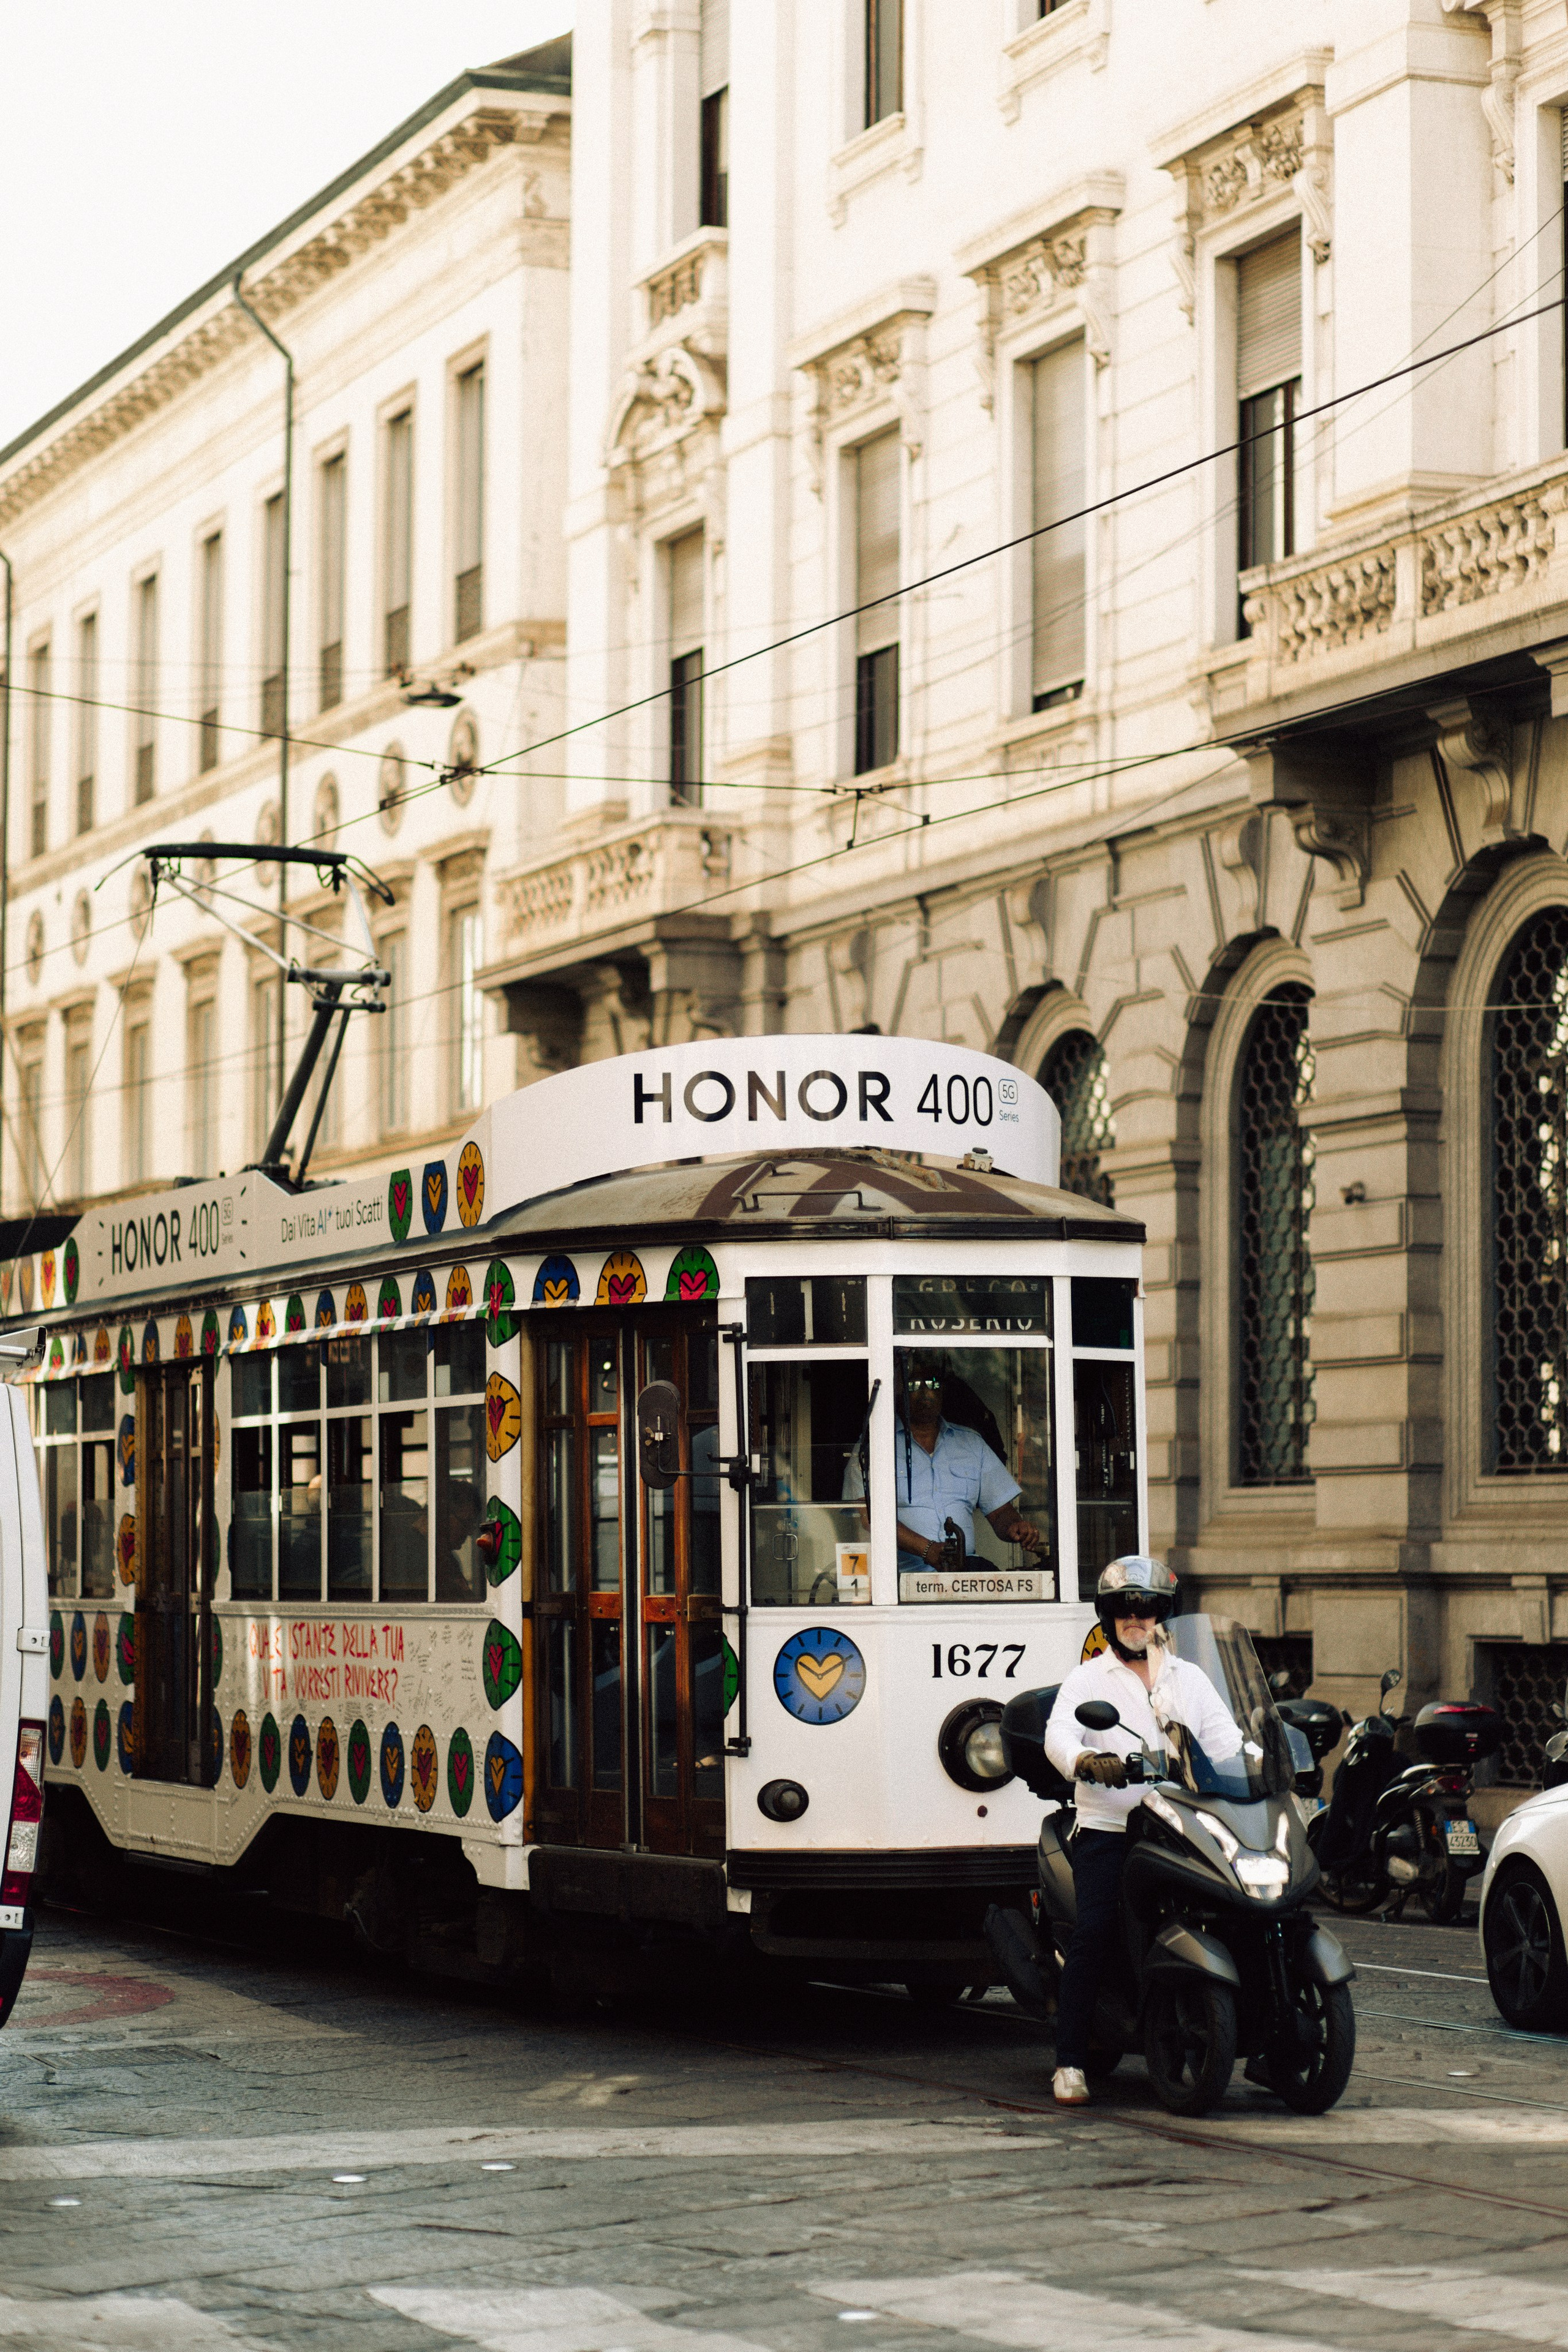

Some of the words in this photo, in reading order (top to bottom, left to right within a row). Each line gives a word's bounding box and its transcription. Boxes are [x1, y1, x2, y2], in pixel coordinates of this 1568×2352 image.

[633, 1069, 894, 1124] HONOR
[917, 1074, 993, 1126] 400
[1002, 1084, 1015, 1099] 5G
[999, 1109, 1019, 1123] Series
[281, 1216, 296, 1243] Dai
[298, 1213, 315, 1238] Vita
[336, 1202, 353, 1230] tuoi
[356, 1195, 383, 1226] Scatti
[111, 1210, 181, 1275] HONOR
[189, 1200, 219, 1257] 400
[849, 1556, 859, 1575] 7
[851, 1578, 858, 1597] 1
[916, 1581, 948, 1593] term.
[952, 1580, 1013, 1593] CERTOSA
[1017, 1579, 1033, 1593] FS
[249, 1623, 282, 1659] QUAE
[288, 1622, 336, 1659] ISTANTE
[342, 1622, 379, 1659] DELLA
[382, 1624, 404, 1662] TUA
[932, 1643, 1026, 1678] 1677
[262, 1665, 288, 1701] VTA
